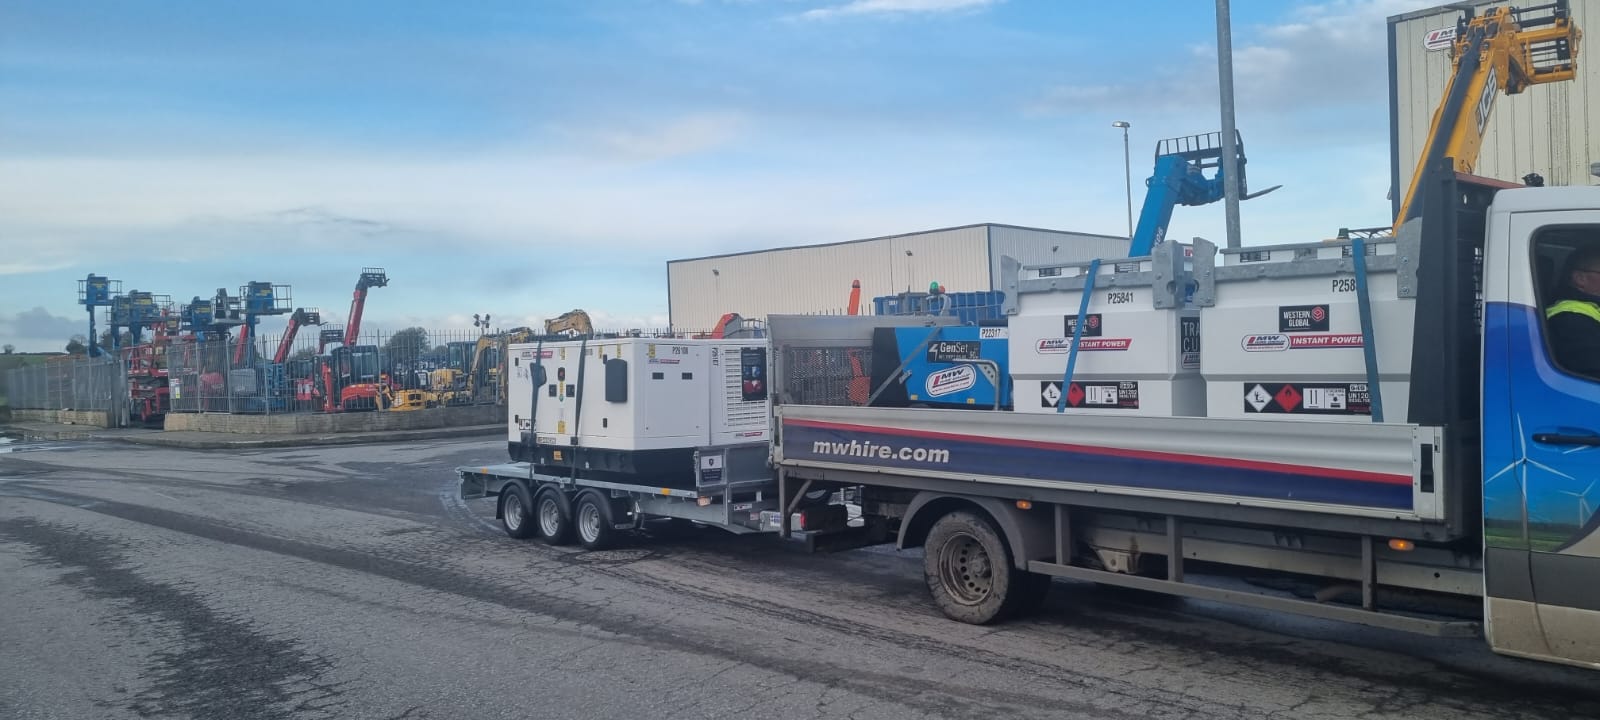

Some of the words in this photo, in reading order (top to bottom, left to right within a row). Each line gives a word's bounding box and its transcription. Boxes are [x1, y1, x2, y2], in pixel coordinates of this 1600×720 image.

[1478, 67, 1497, 132] JCB
[1332, 279, 1356, 292] P258
[1107, 292, 1134, 304] P25841
[1283, 311, 1310, 319] WESTERN
[1288, 318, 1309, 327] GLOBAL
[1292, 336, 1329, 345] INSTANT
[1331, 335, 1364, 344] POWER
[940, 342, 968, 353] GenSet
[813, 439, 949, 463] mwhire.com
